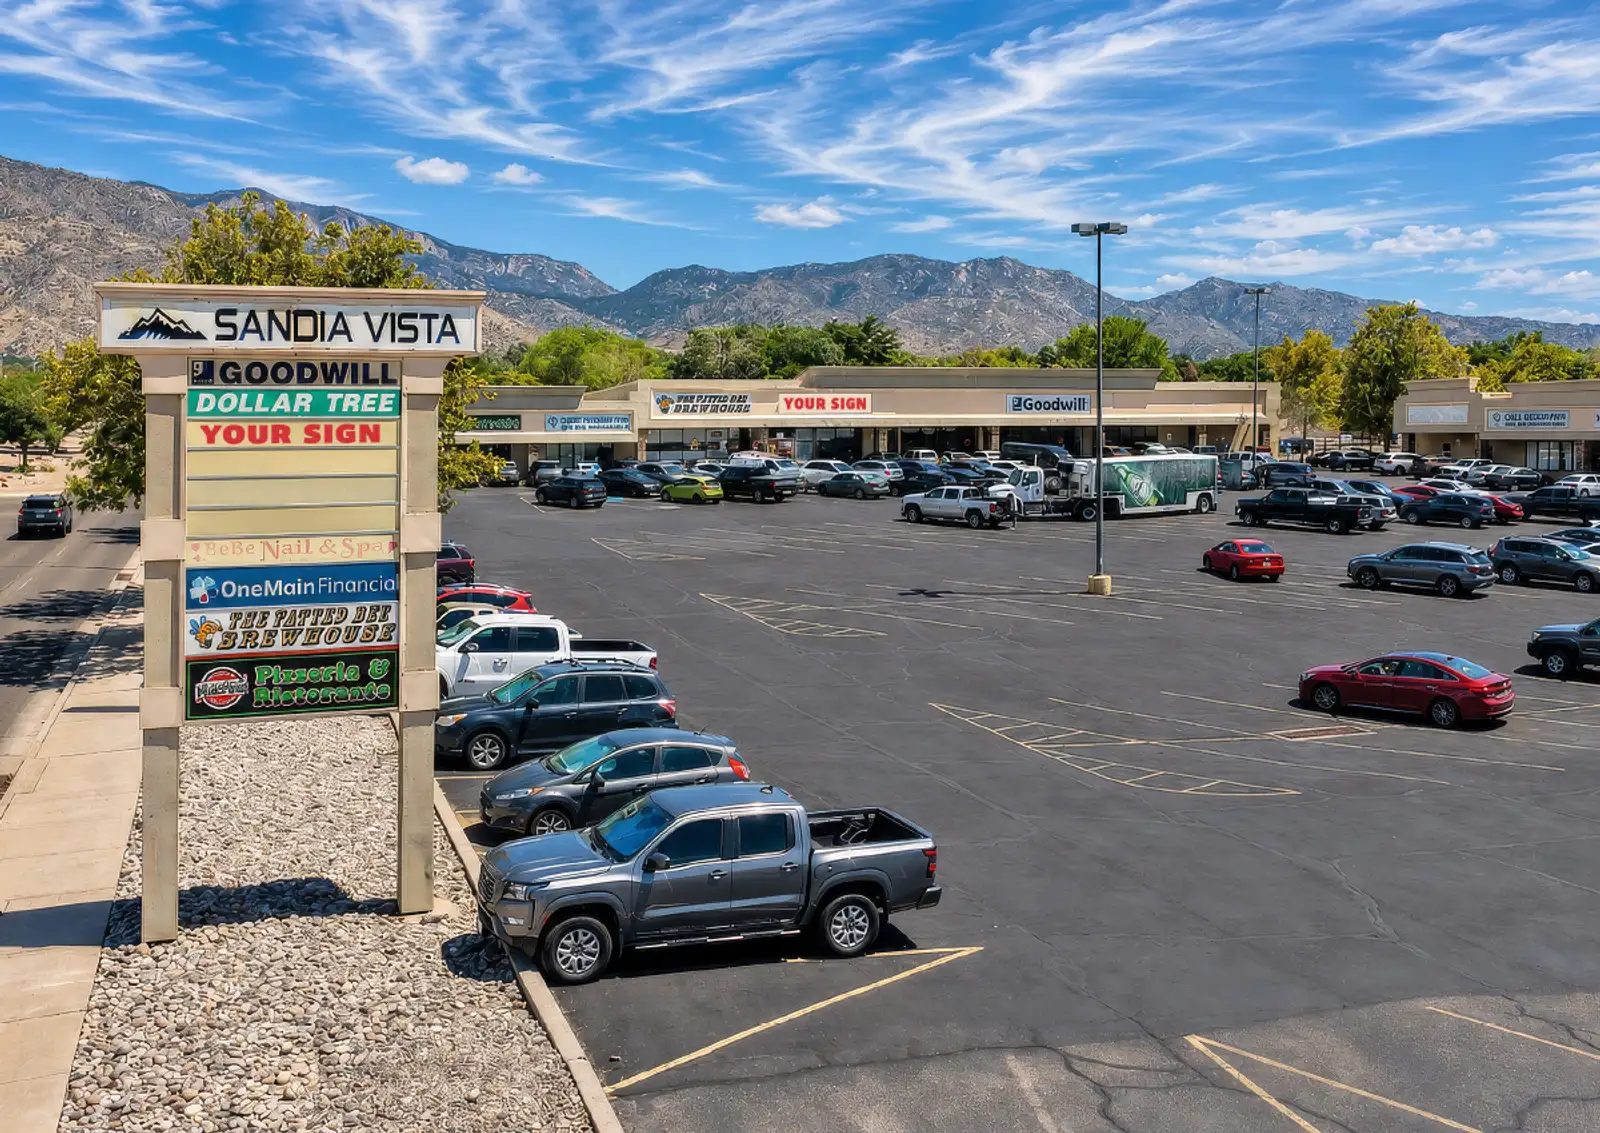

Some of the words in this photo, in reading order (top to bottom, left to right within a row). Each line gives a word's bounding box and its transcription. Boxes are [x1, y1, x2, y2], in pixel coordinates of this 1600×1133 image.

[214, 308, 353, 343] SANDIA
[363, 312, 461, 344] VISTA
[219, 361, 398, 384] GOODWILL
[196, 393, 311, 413] DOLLAR
[327, 393, 396, 412] TREE
[783, 397, 826, 410] YOUR
[831, 397, 867, 410] SIGN
[1023, 398, 1086, 411] Goodwill
[200, 425, 291, 444] YOUR
[303, 423, 381, 444] SIGN
[204, 540, 256, 556] BeBe
[259, 538, 314, 561] Nail
[319, 539, 337, 555] &
[340, 537, 384, 559] Spa
[221, 578, 315, 598] OneMain
[318, 574, 396, 594] Financia
